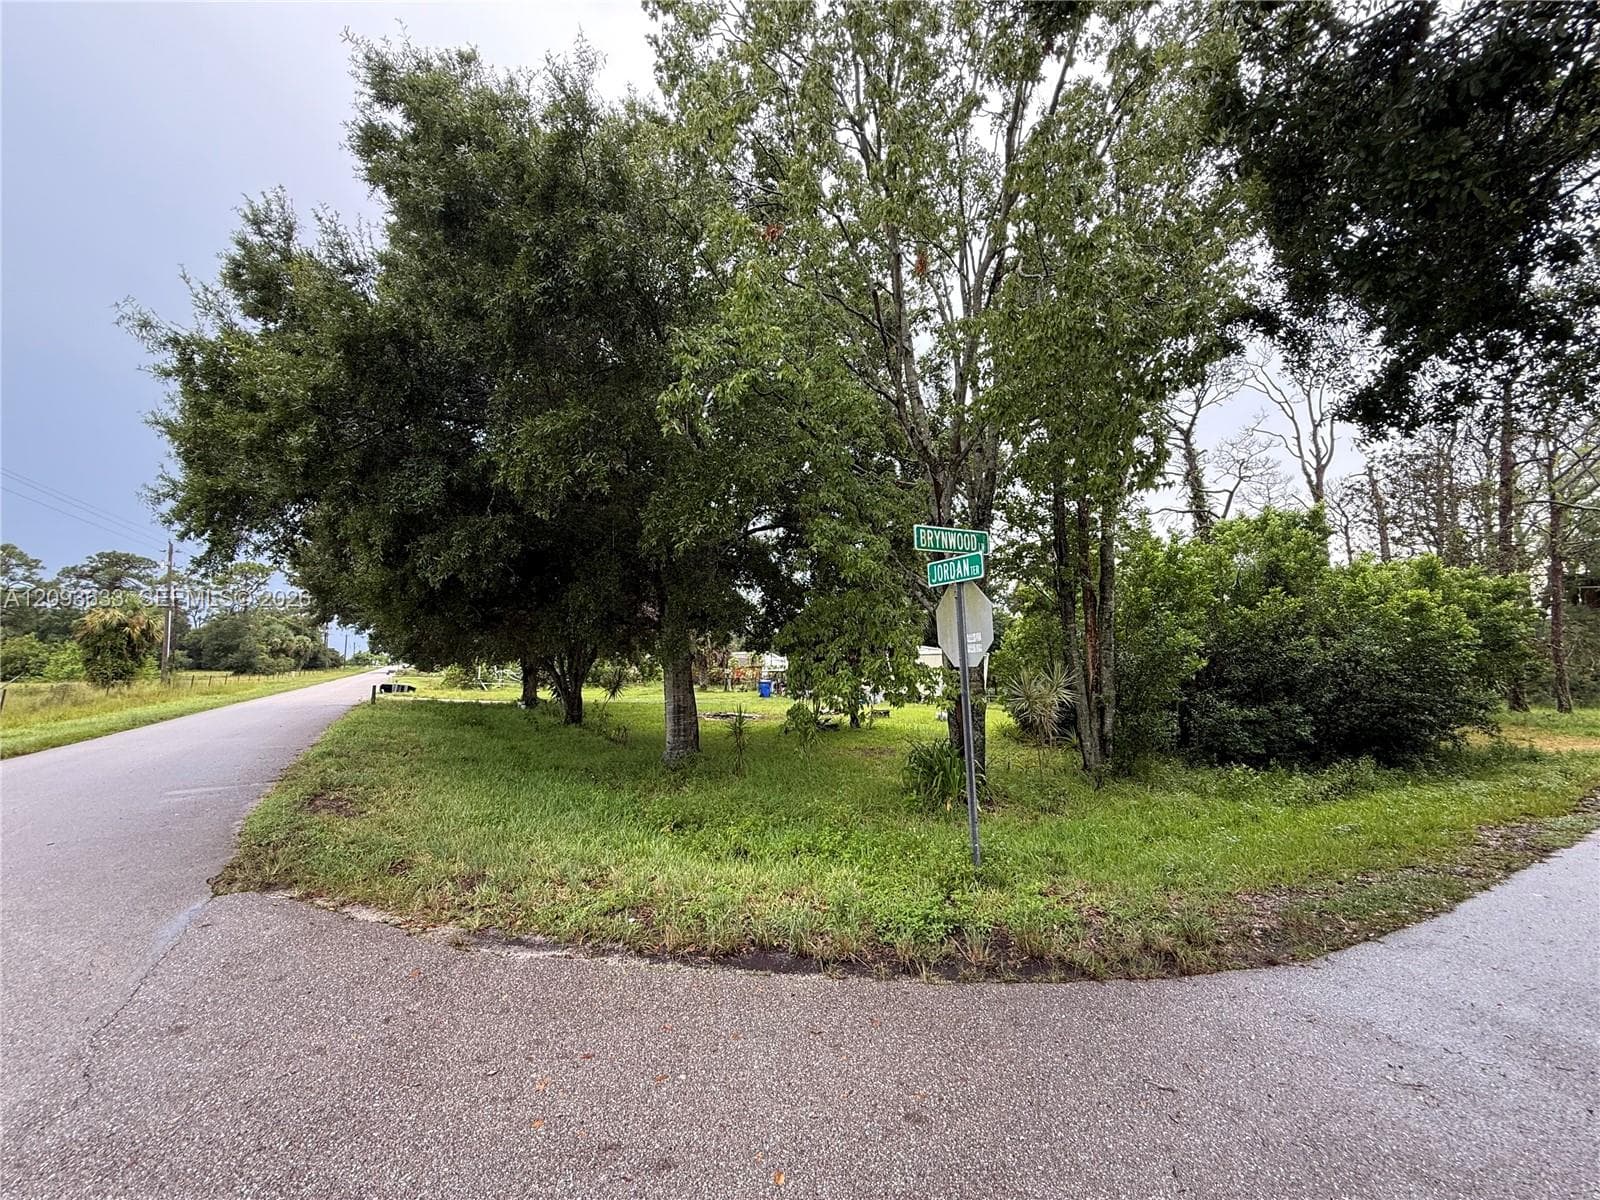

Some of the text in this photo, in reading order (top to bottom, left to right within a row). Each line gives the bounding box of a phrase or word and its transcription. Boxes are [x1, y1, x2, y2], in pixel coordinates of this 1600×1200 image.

[919, 528, 977, 552] BRYNWOOD
[931, 558, 980, 583] JORDAN TER
